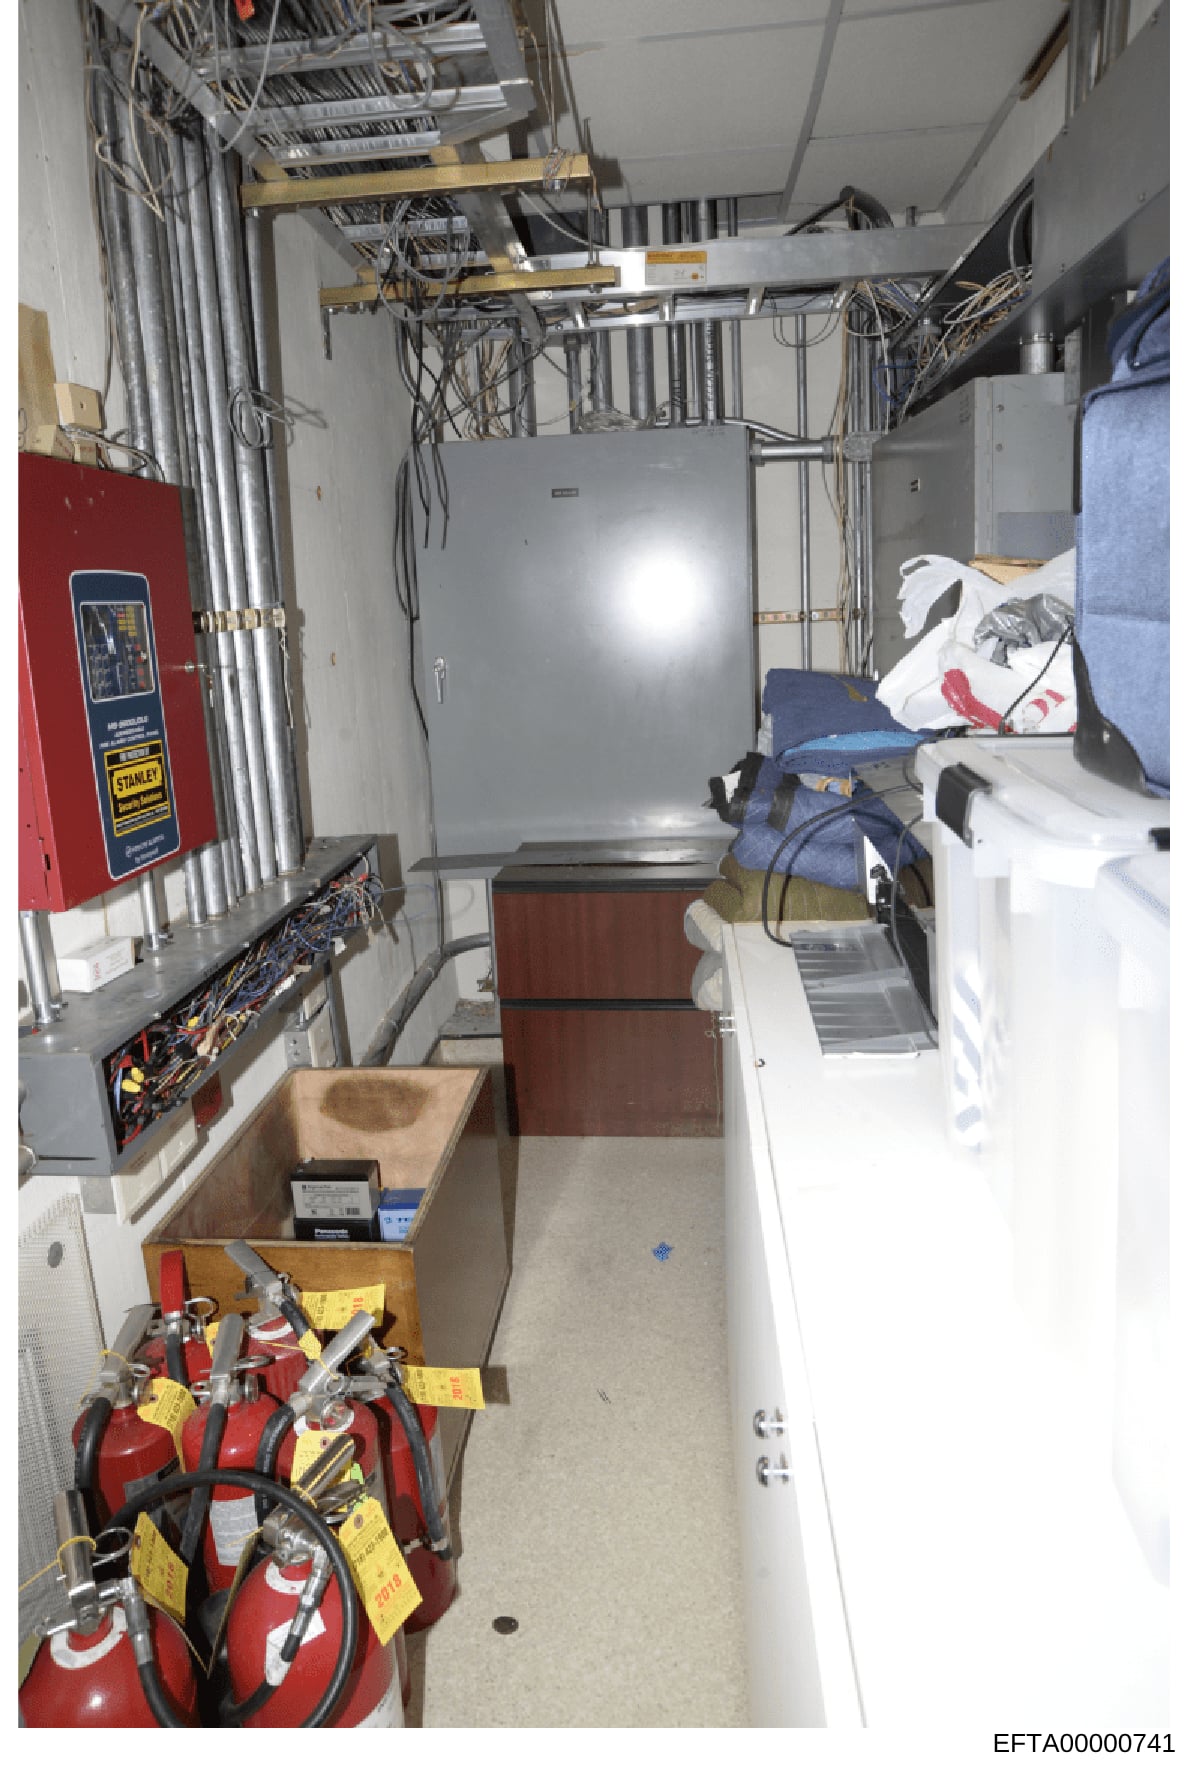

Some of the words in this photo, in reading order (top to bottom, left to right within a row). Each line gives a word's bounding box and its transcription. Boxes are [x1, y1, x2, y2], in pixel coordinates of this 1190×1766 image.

[116, 768, 157, 792] STANLEY
[118, 799, 141, 813] Security
[141, 792, 163, 804] Solutions
[350, 1298, 364, 1316] 018
[375, 1573, 402, 1608] 2018
